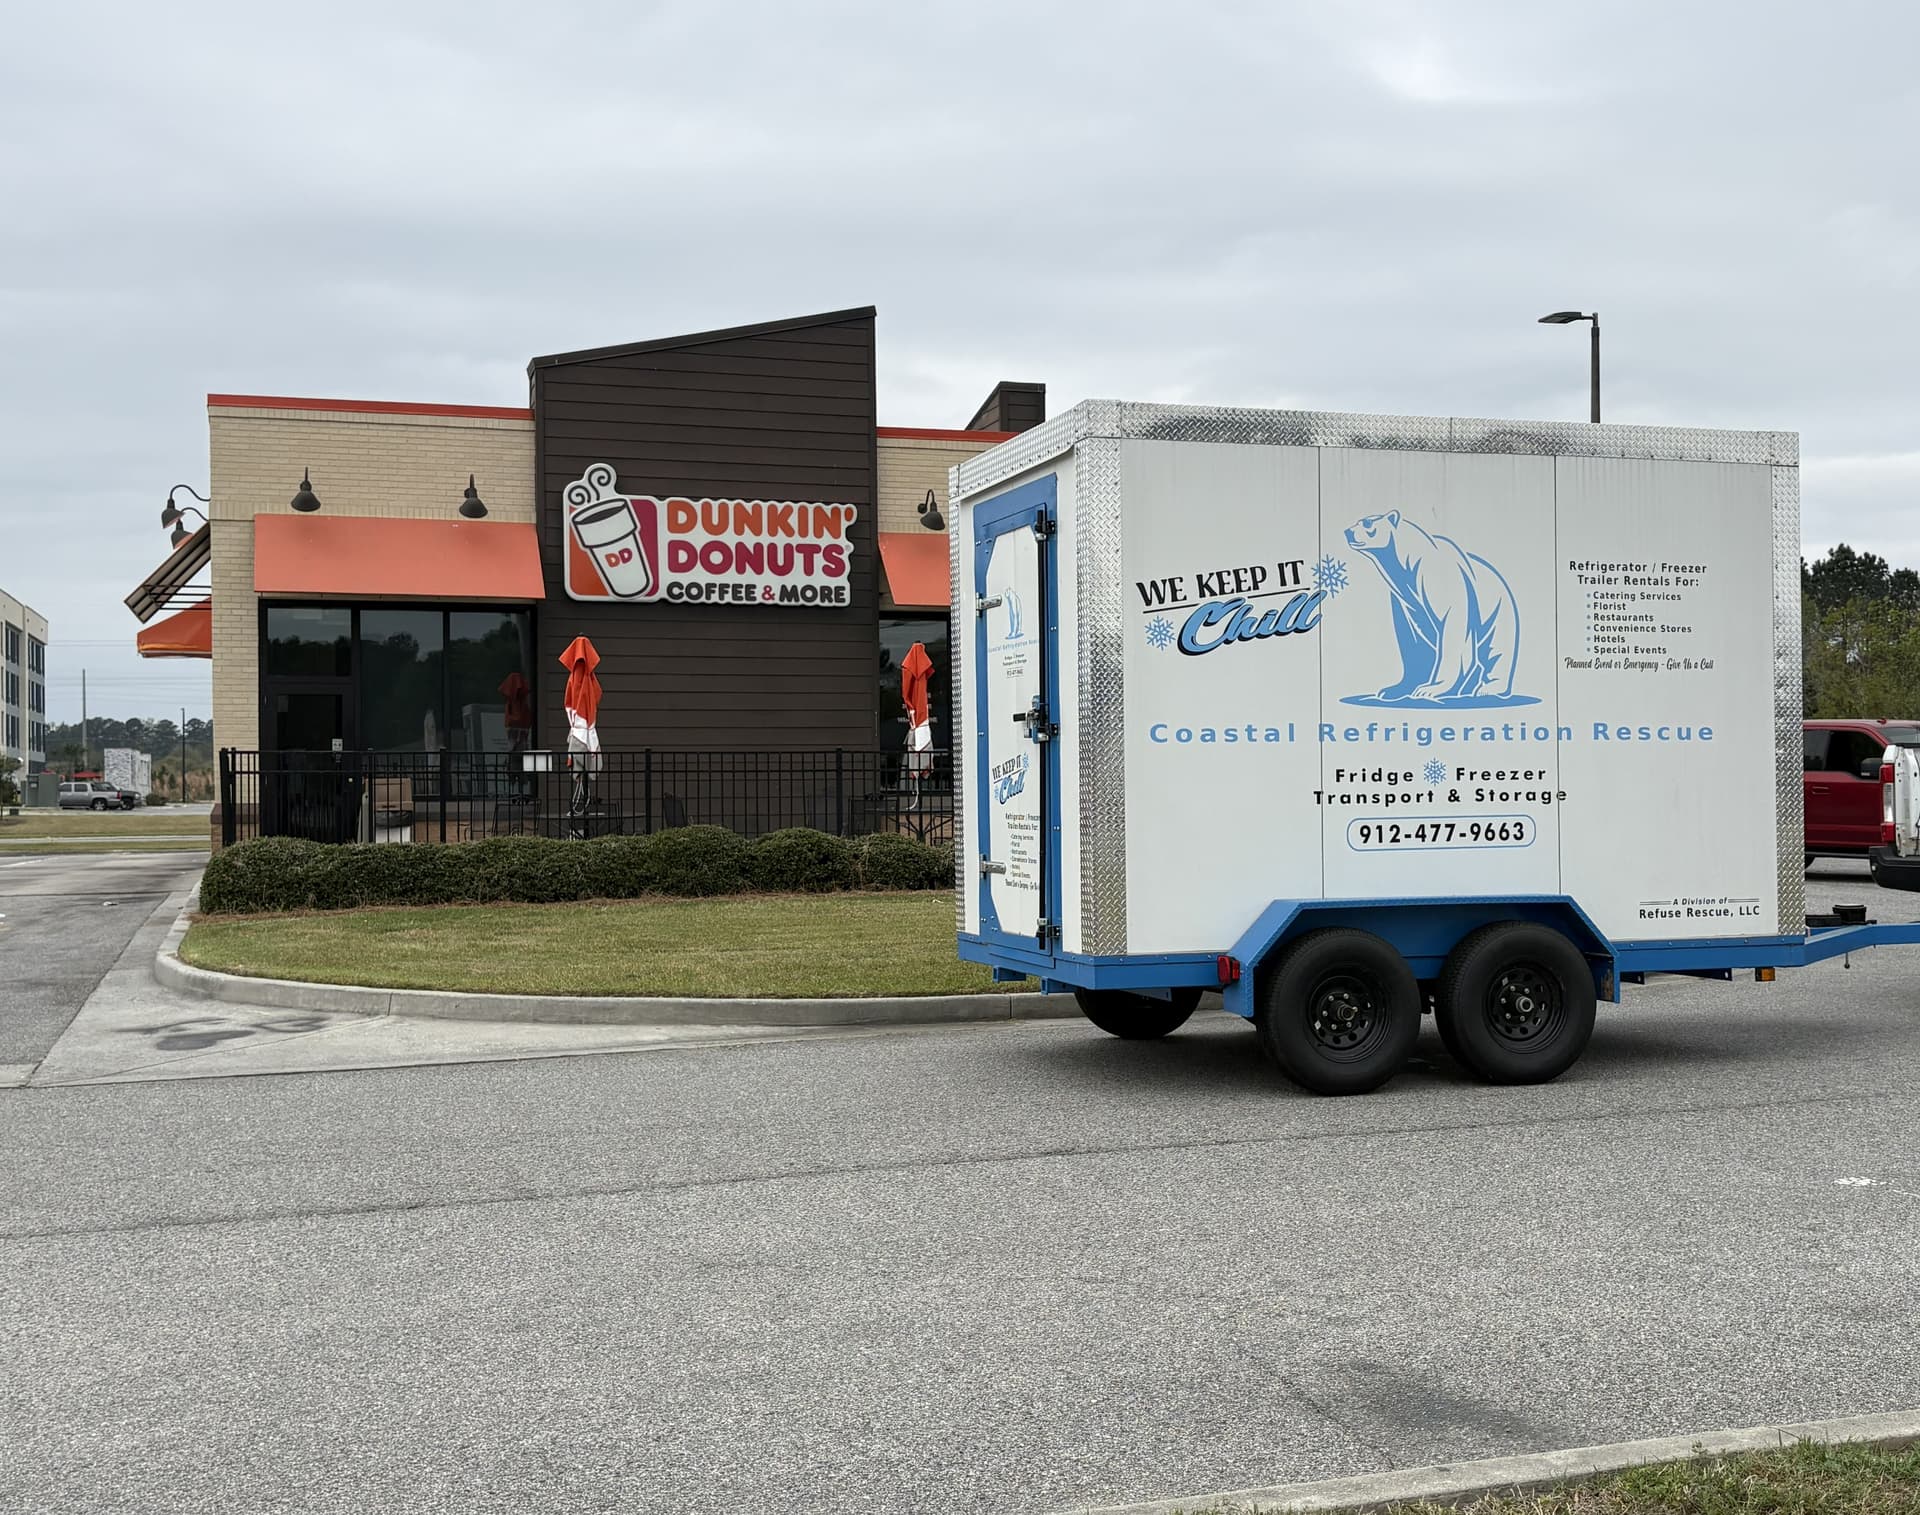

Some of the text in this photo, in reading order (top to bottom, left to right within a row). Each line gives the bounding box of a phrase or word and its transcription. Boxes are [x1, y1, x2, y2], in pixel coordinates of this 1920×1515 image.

[667, 500, 854, 539] DUNKIN'
[667, 540, 846, 577] DONUTS
[1569, 561, 1647, 574] Refrigerator
[1661, 562, 1707, 573] Freezer
[1136, 560, 1304, 607] WE KEEP IT
[1577, 575, 1699, 586] Trailer Rentals For:
[666, 581, 846, 603] COFFEE & MORE
[1593, 591, 1681, 601] Catering Services
[1593, 602, 1626, 611] Florist
[1177, 590, 1327, 656] Chill
[1593, 613, 1654, 622] Restaurants
[1593, 624, 1692, 633] Convenience Stores
[1594, 634, 1626, 643] Hotels
[1594, 646, 1667, 655] Special Events
[1564, 657, 1592, 669] Planned
[1623, 658, 1659, 672] Emergency
[1666, 658, 1681, 670] Give
[1700, 658, 1714, 670] Call
[1149, 722, 1713, 746] Coastal Refrigeration Rescue
[1335, 767, 1547, 785] Fridge Freezer
[1313, 788, 1567, 807] Transport & Storage
[1359, 822, 1525, 844] 912-477-9663
[1719, 897, 1727, 905] of
[1639, 905, 1760, 919] Refuse Rescue, LLC
